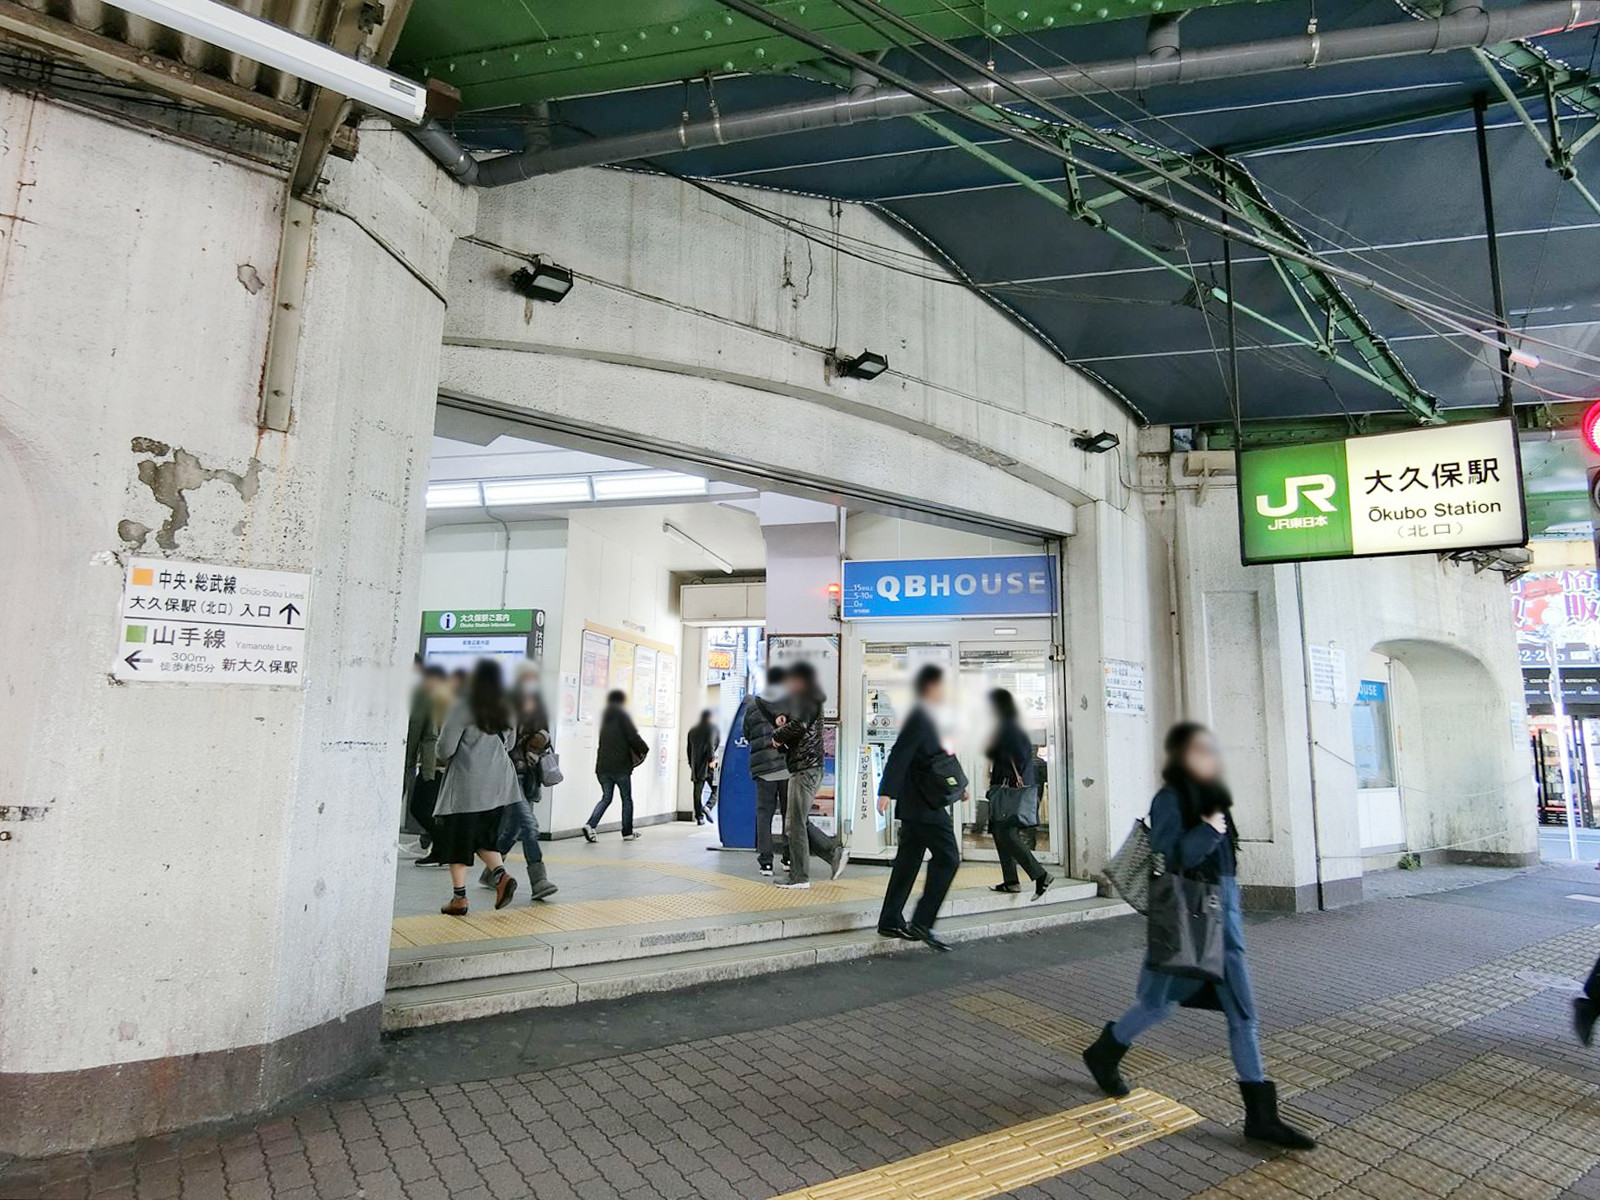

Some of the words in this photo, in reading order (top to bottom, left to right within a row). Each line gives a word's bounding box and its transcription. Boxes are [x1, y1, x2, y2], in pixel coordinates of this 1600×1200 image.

[1365, 457, 1500, 495] 大久保駅
[1256, 473, 1338, 517] JR
[1434, 500, 1502, 518] Station
[1268, 515, 1329, 531] JR東日本
[240, 603, 271, 618] 入口
[153, 625, 226, 649] 山手線
[171, 652, 207, 663] 300m
[222, 658, 298, 674] 新大久保駅
